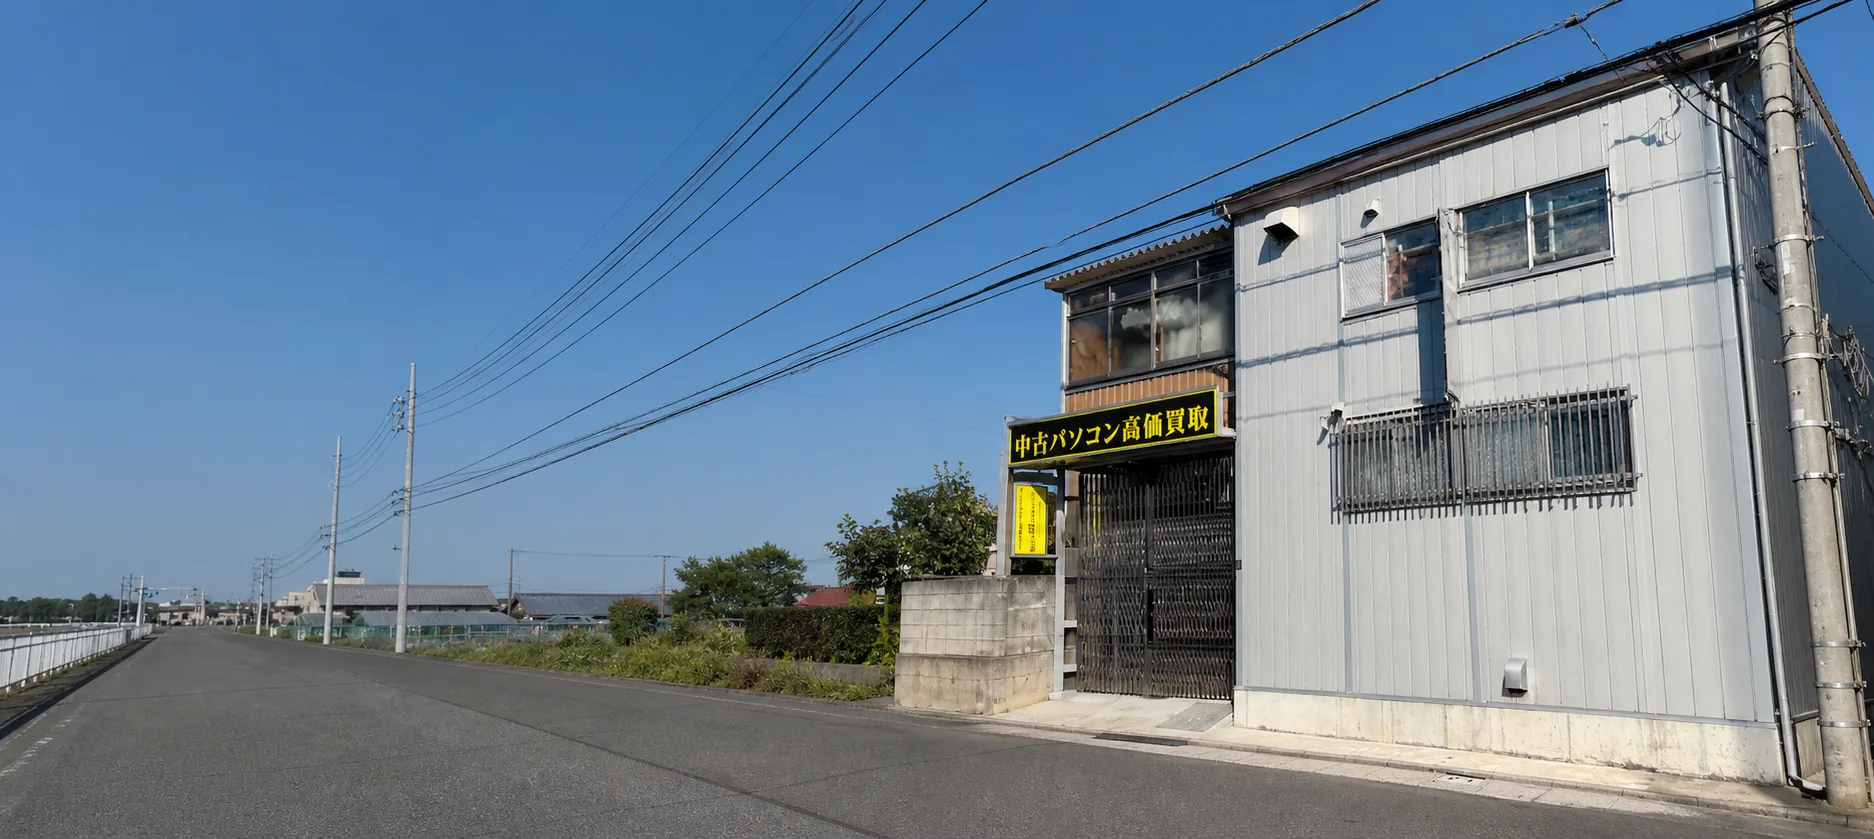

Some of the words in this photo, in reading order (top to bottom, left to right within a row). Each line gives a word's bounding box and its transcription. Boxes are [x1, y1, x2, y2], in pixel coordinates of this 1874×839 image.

[1015, 405, 1209, 458] 中古パソコン高価買取
